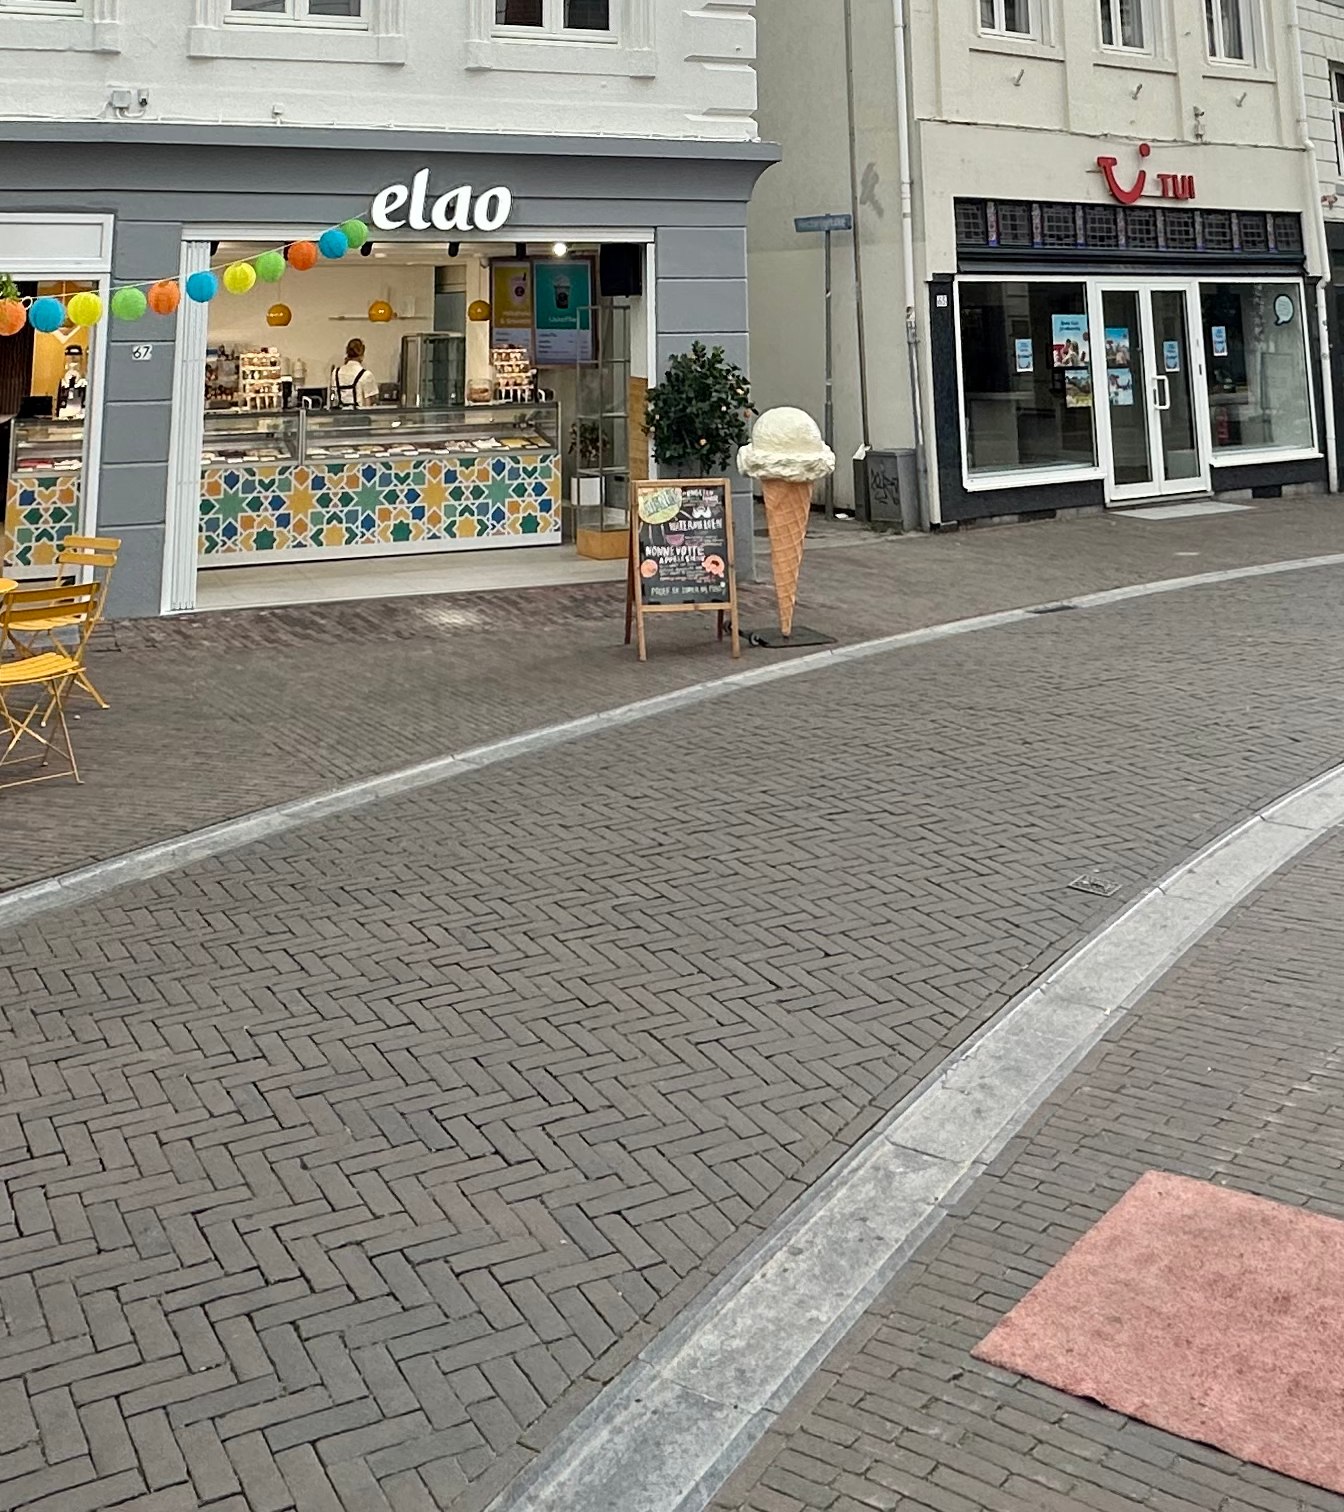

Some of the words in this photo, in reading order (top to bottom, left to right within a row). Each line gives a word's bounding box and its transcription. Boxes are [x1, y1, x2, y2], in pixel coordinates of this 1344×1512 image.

[372, 167, 512, 232] elao
[1157, 174, 1195, 200] TUI
[133, 346, 150, 359] 67
